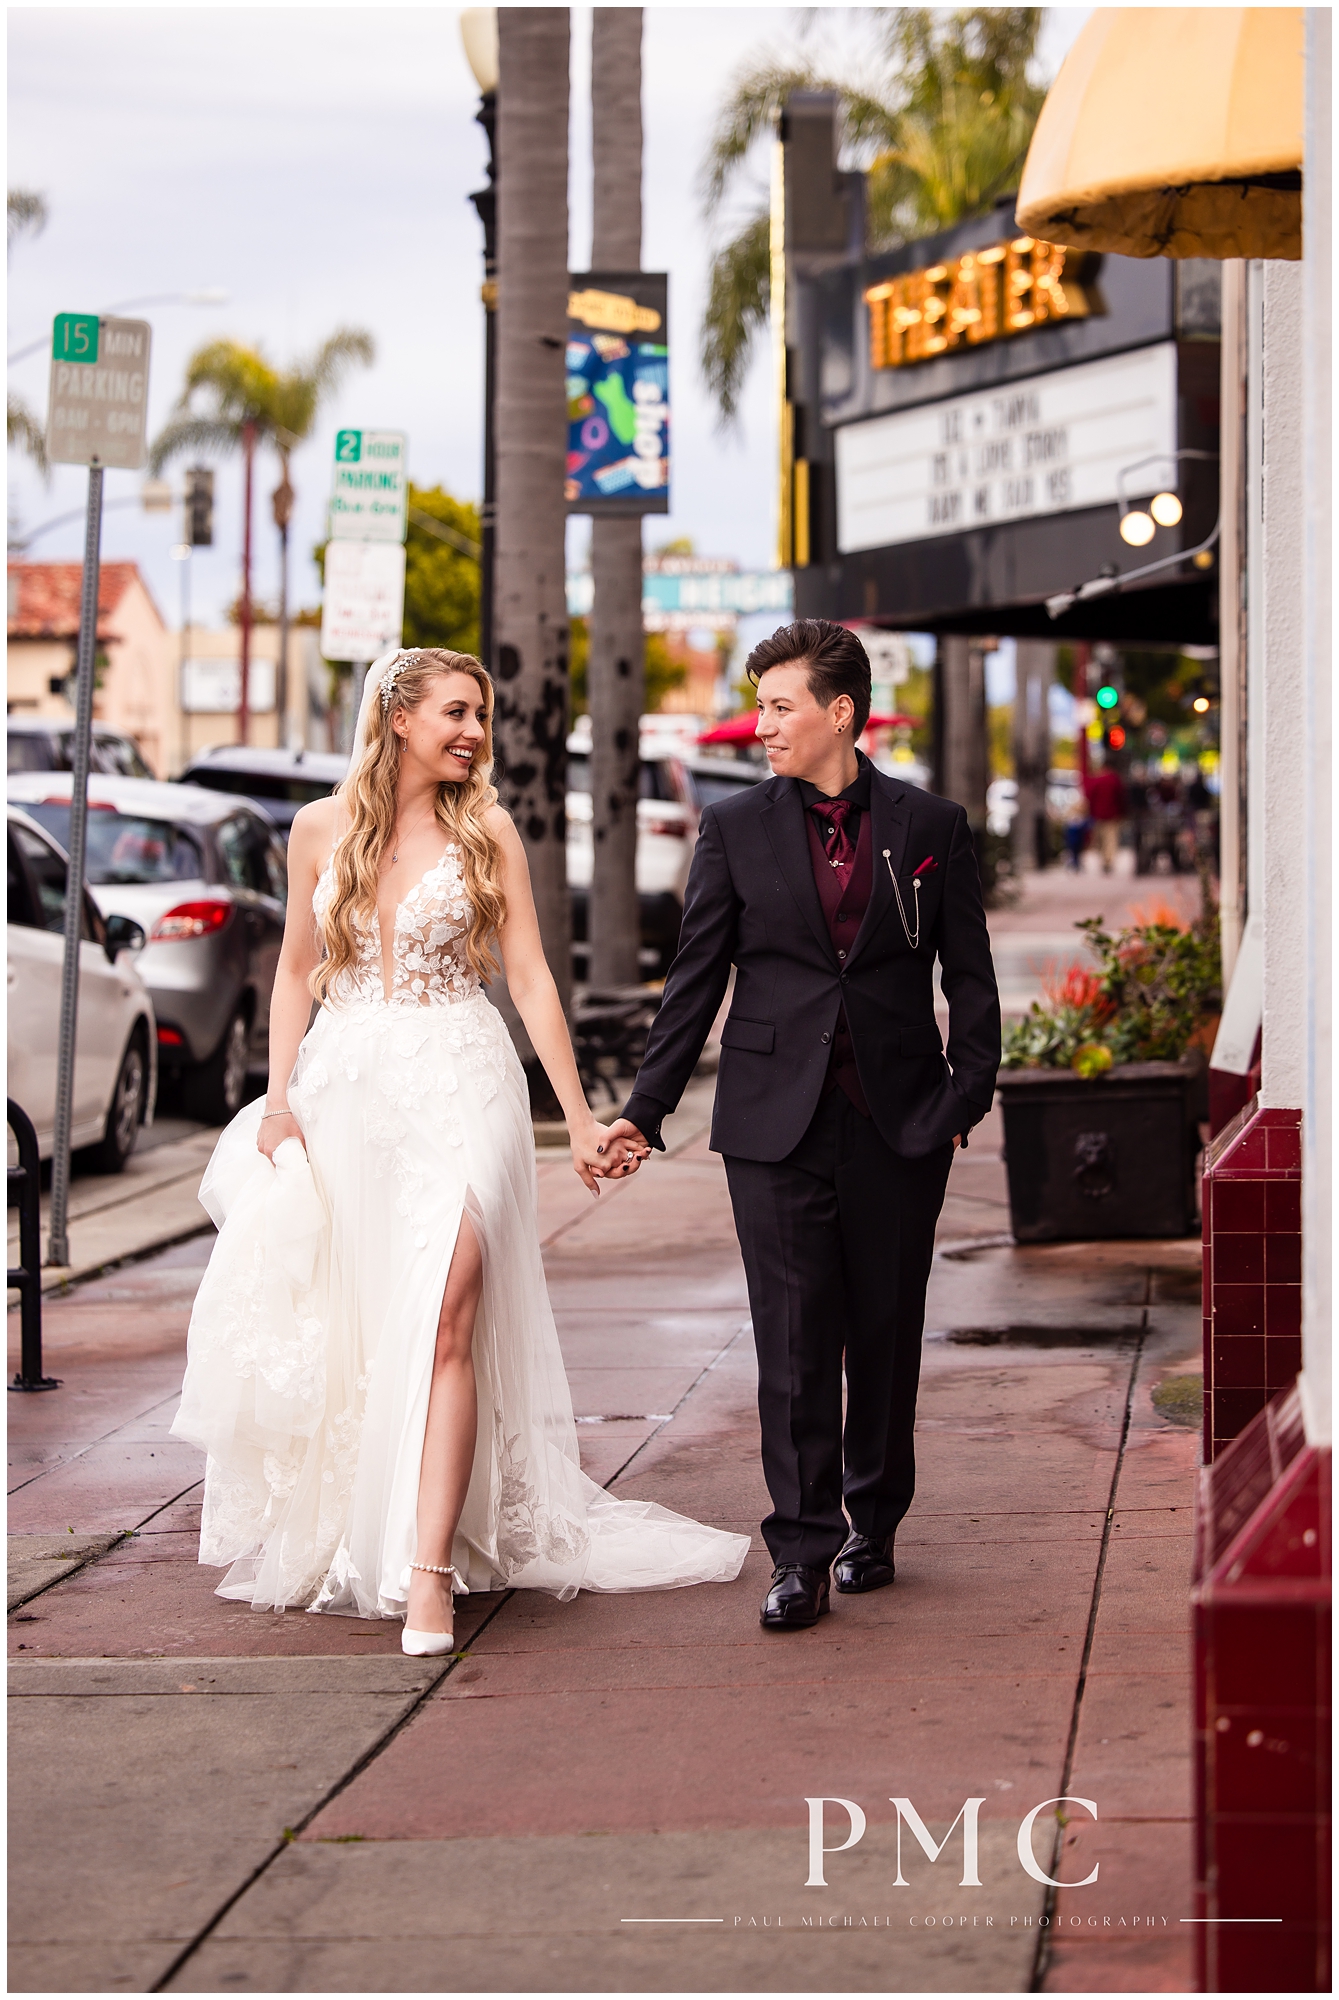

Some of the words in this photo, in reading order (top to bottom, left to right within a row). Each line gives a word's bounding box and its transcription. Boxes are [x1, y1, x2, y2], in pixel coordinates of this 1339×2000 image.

[865, 236, 1069, 369] THEATER
[64, 322, 88, 353] 15
[105, 331, 142, 357] MIN
[57, 366, 143, 403] PARKING
[341, 433, 358, 458] 2
[629, 380, 667, 489] shop
[337, 470, 398, 491] PARKING
